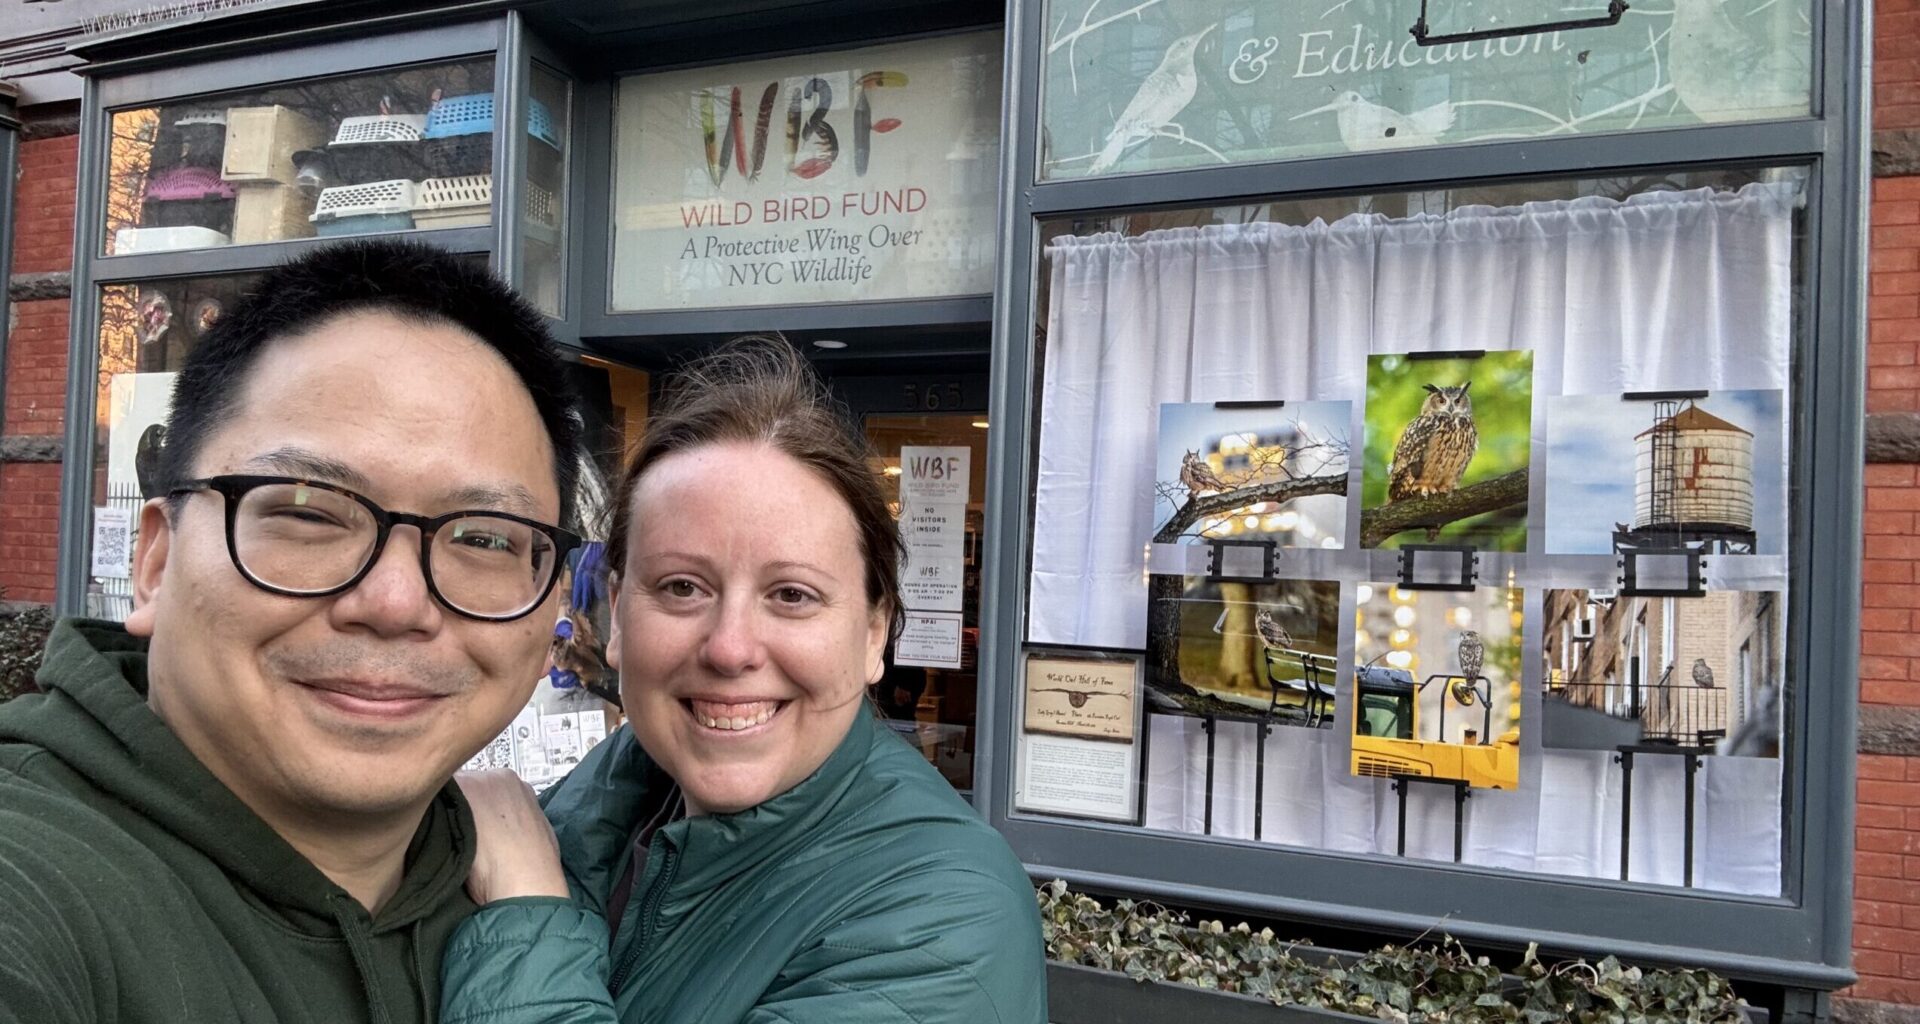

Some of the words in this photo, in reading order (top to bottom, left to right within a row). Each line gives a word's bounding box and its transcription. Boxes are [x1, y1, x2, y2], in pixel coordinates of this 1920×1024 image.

[1228, 36, 1279, 85] &
[1292, 24, 1566, 79] Education
[701, 71, 910, 189] WBF
[680, 202, 752, 230] WILD
[763, 196, 831, 224] BIRD
[842, 187, 928, 217] FUND
[680, 238, 700, 260] A
[704, 234, 800, 259] Protective
[806, 227, 863, 254] Wing
[868, 223, 924, 248] Over
[728, 262, 784, 287] NYC
[791, 256, 873, 286] Wildlife
[903, 382, 962, 410] 565
[909, 456, 960, 481] WBF
[919, 566, 940, 577] WBF
